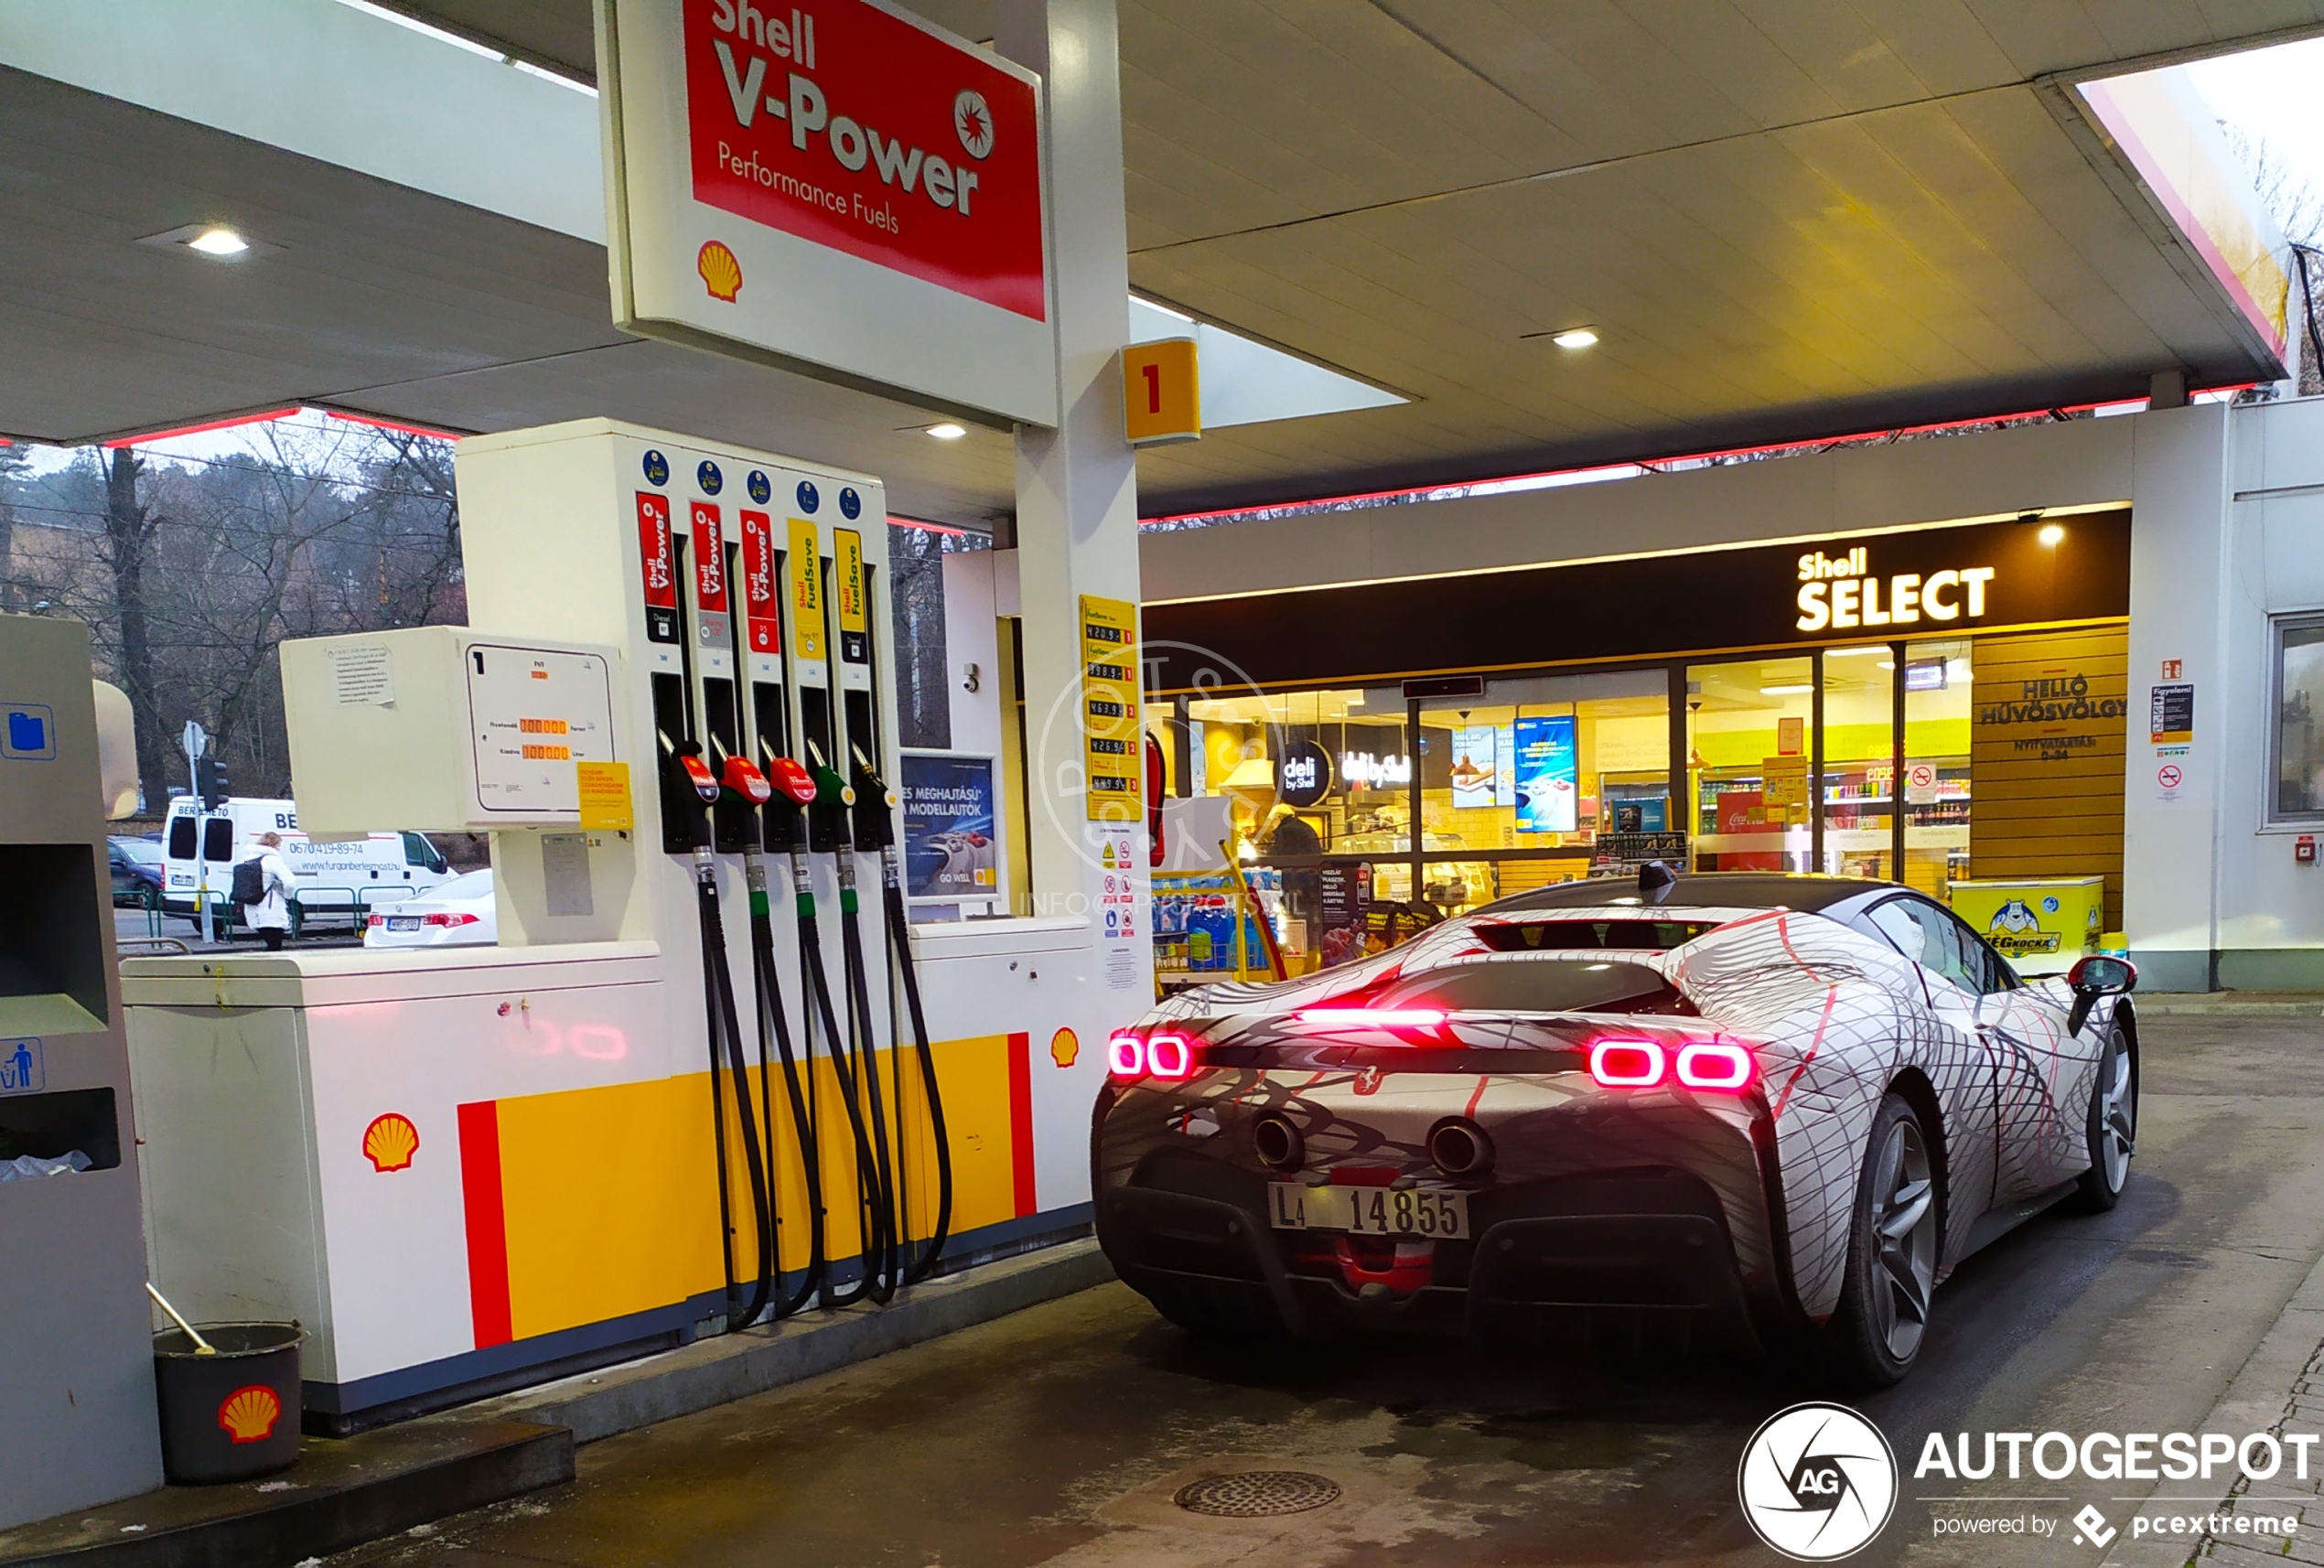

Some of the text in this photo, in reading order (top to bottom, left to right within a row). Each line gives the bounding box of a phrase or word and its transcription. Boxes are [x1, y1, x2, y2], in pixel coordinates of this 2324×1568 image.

[711, 0, 816, 70] Shell
[713, 38, 978, 217] V-Power
[718, 141, 900, 234] Performance Fuels
[1142, 364, 1160, 413] 1
[655, 510, 669, 588] V-Power
[707, 518, 721, 594] V-Power
[647, 558, 658, 588] Shell
[758, 527, 769, 601] V-Power
[804, 537, 816, 609] FuelSave
[1798, 547, 1867, 581] Shell
[700, 564, 711, 594] Shell
[749, 573, 760, 601] Shell
[849, 545, 861, 616] FuelSave
[798, 581, 807, 608] Shell
[843, 588, 852, 614] Shell
[1796, 566, 1996, 632] SELECT
[652, 612, 671, 622] Diesel
[1126, 632, 1131, 642] 1
[473, 651, 485, 674] 1
[1127, 669, 1131, 679] 1
[2153, 686, 2191, 696] Figyelem!
[1128, 706, 1134, 715] 2
[1130, 743, 1135, 752] 2
[1284, 757, 1315, 778] deli
[1342, 751, 1368, 780] deli
[1369, 753, 1384, 789] by
[1132, 780, 1136, 789] 3
[1286, 777, 1315, 791] by Shell
[909, 801, 982, 816] MODELLAUTÓK
[289, 843, 363, 854] 0670 419-89-74
[940, 874, 971, 883] GO WELL
[1350, 1190, 1458, 1234] 14855
